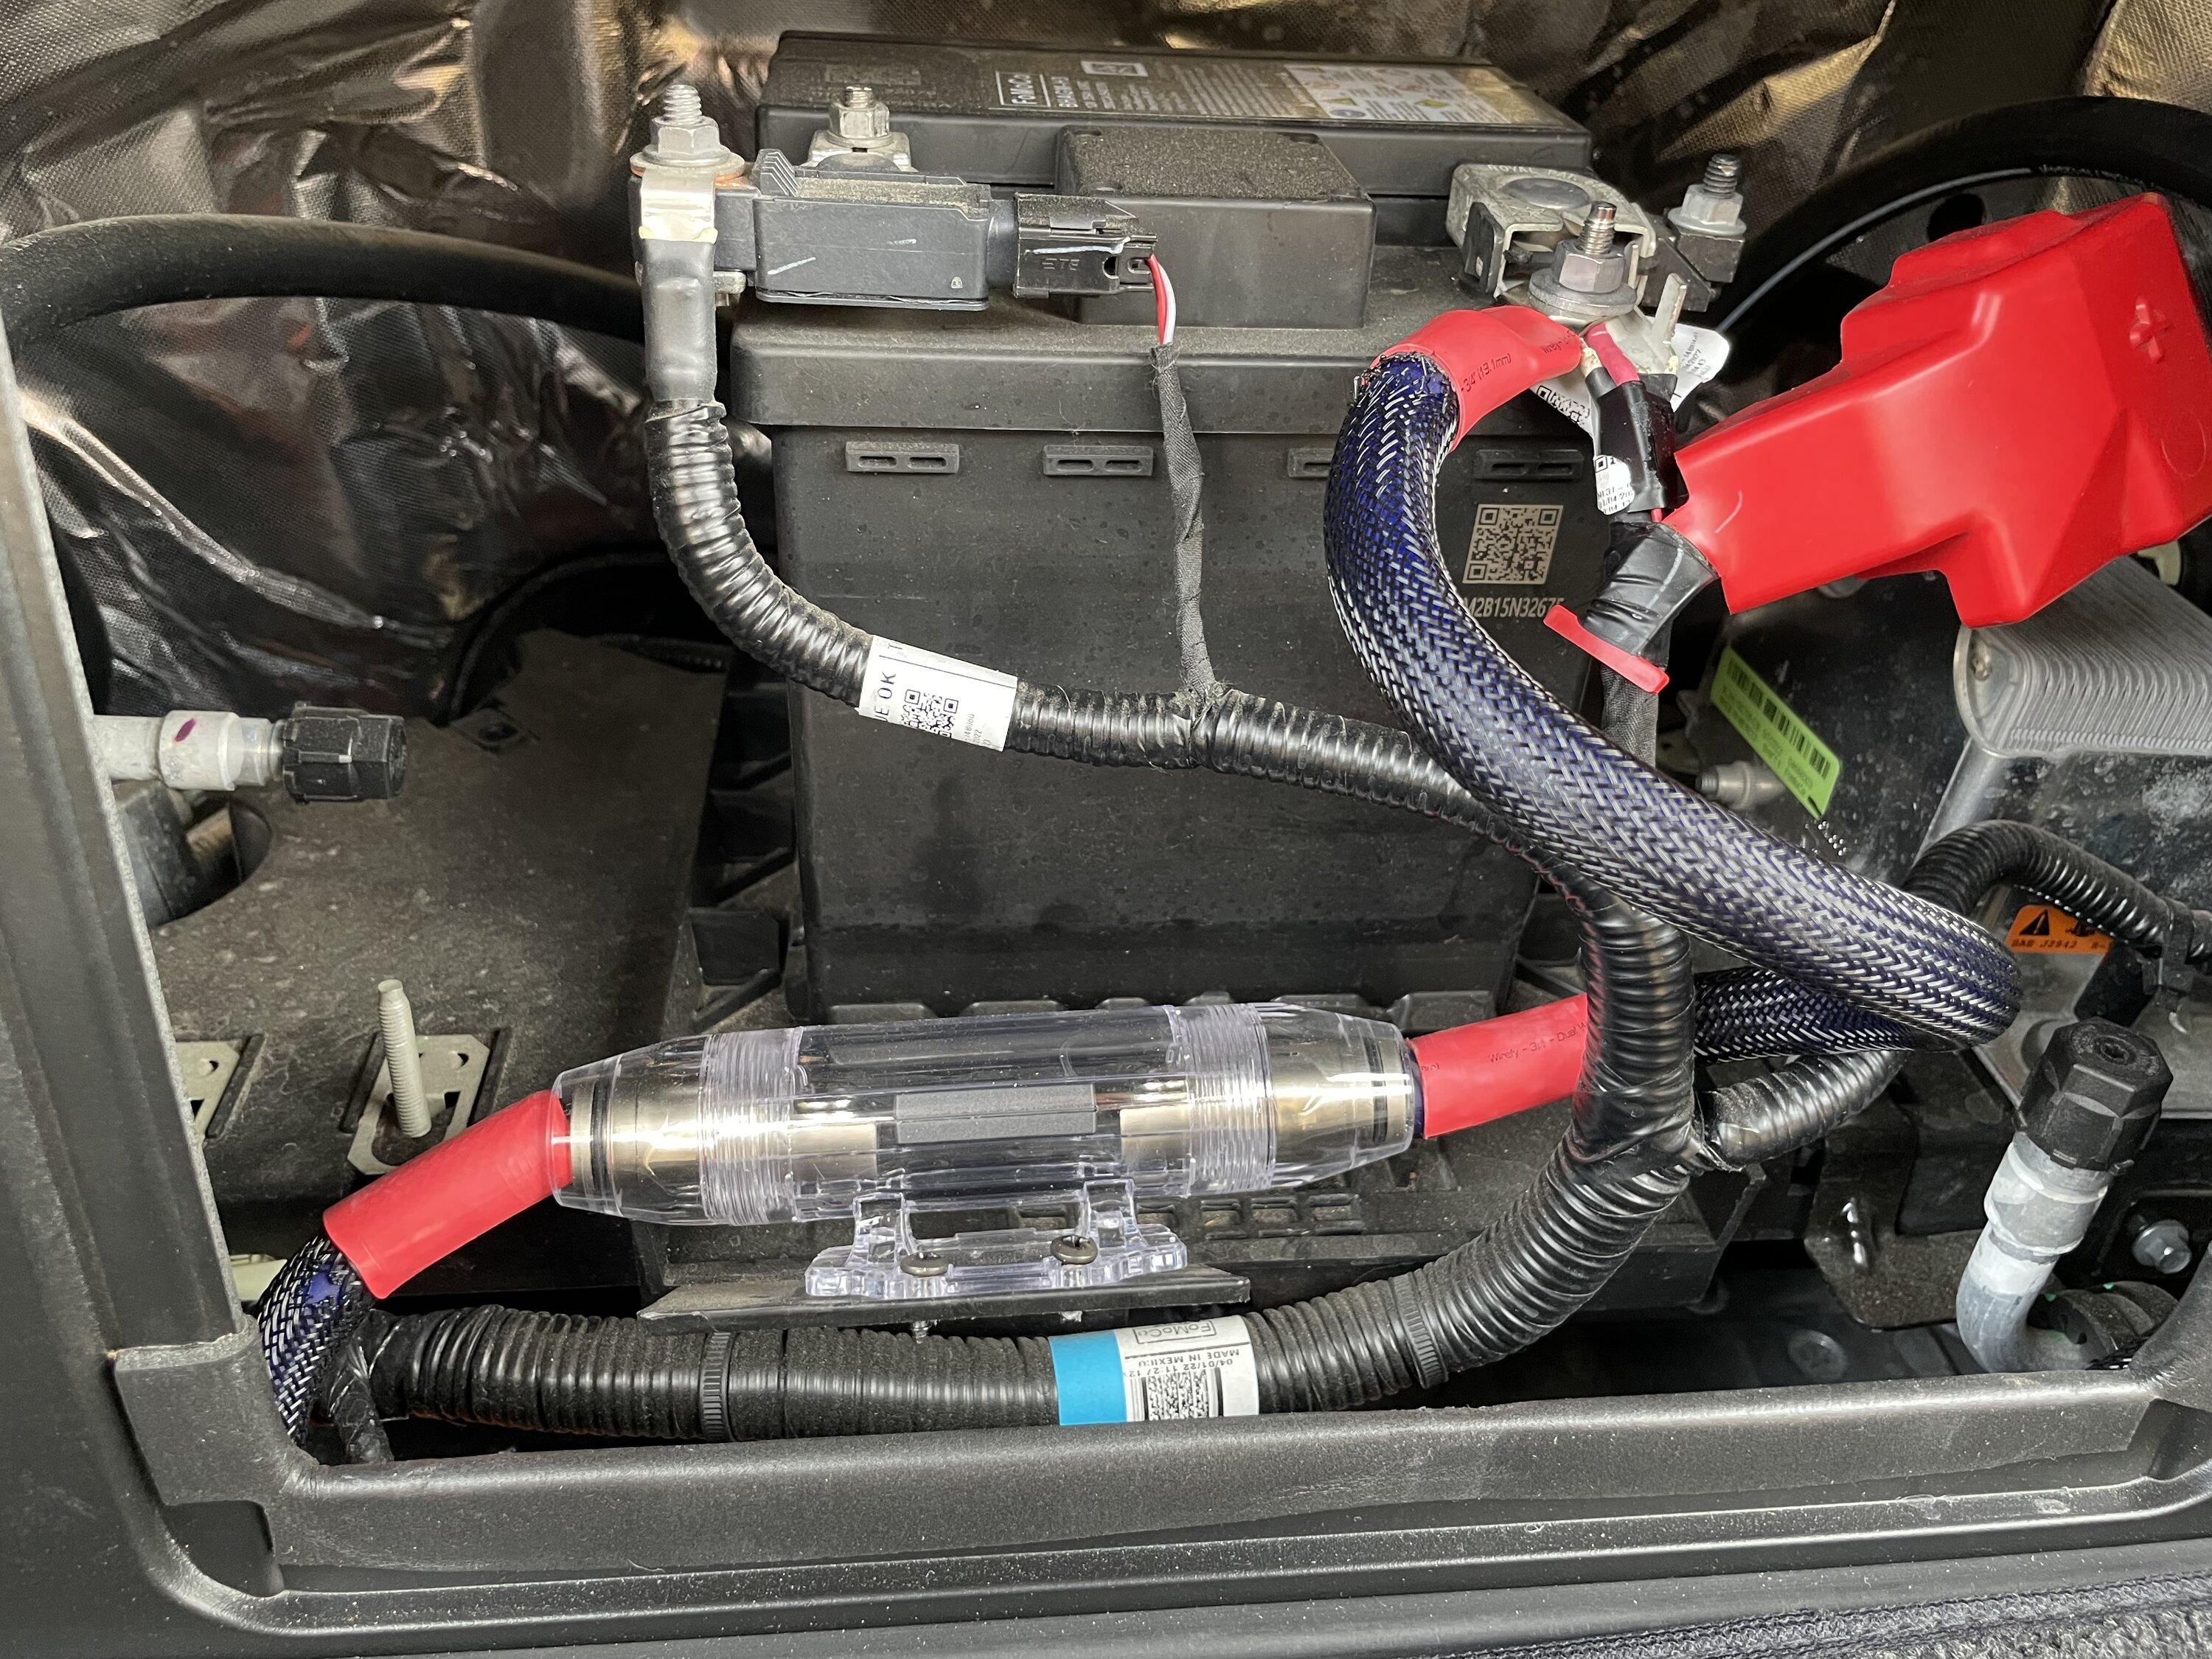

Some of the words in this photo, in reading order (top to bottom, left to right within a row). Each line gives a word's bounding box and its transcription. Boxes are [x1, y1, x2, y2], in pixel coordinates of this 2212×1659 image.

[877, 672, 897, 700] OK
[1138, 1322, 1211, 1338] FoMoCo
[1207, 1349, 1239, 1360] MADE
[1183, 1358, 1233, 1371] 04/01/22
